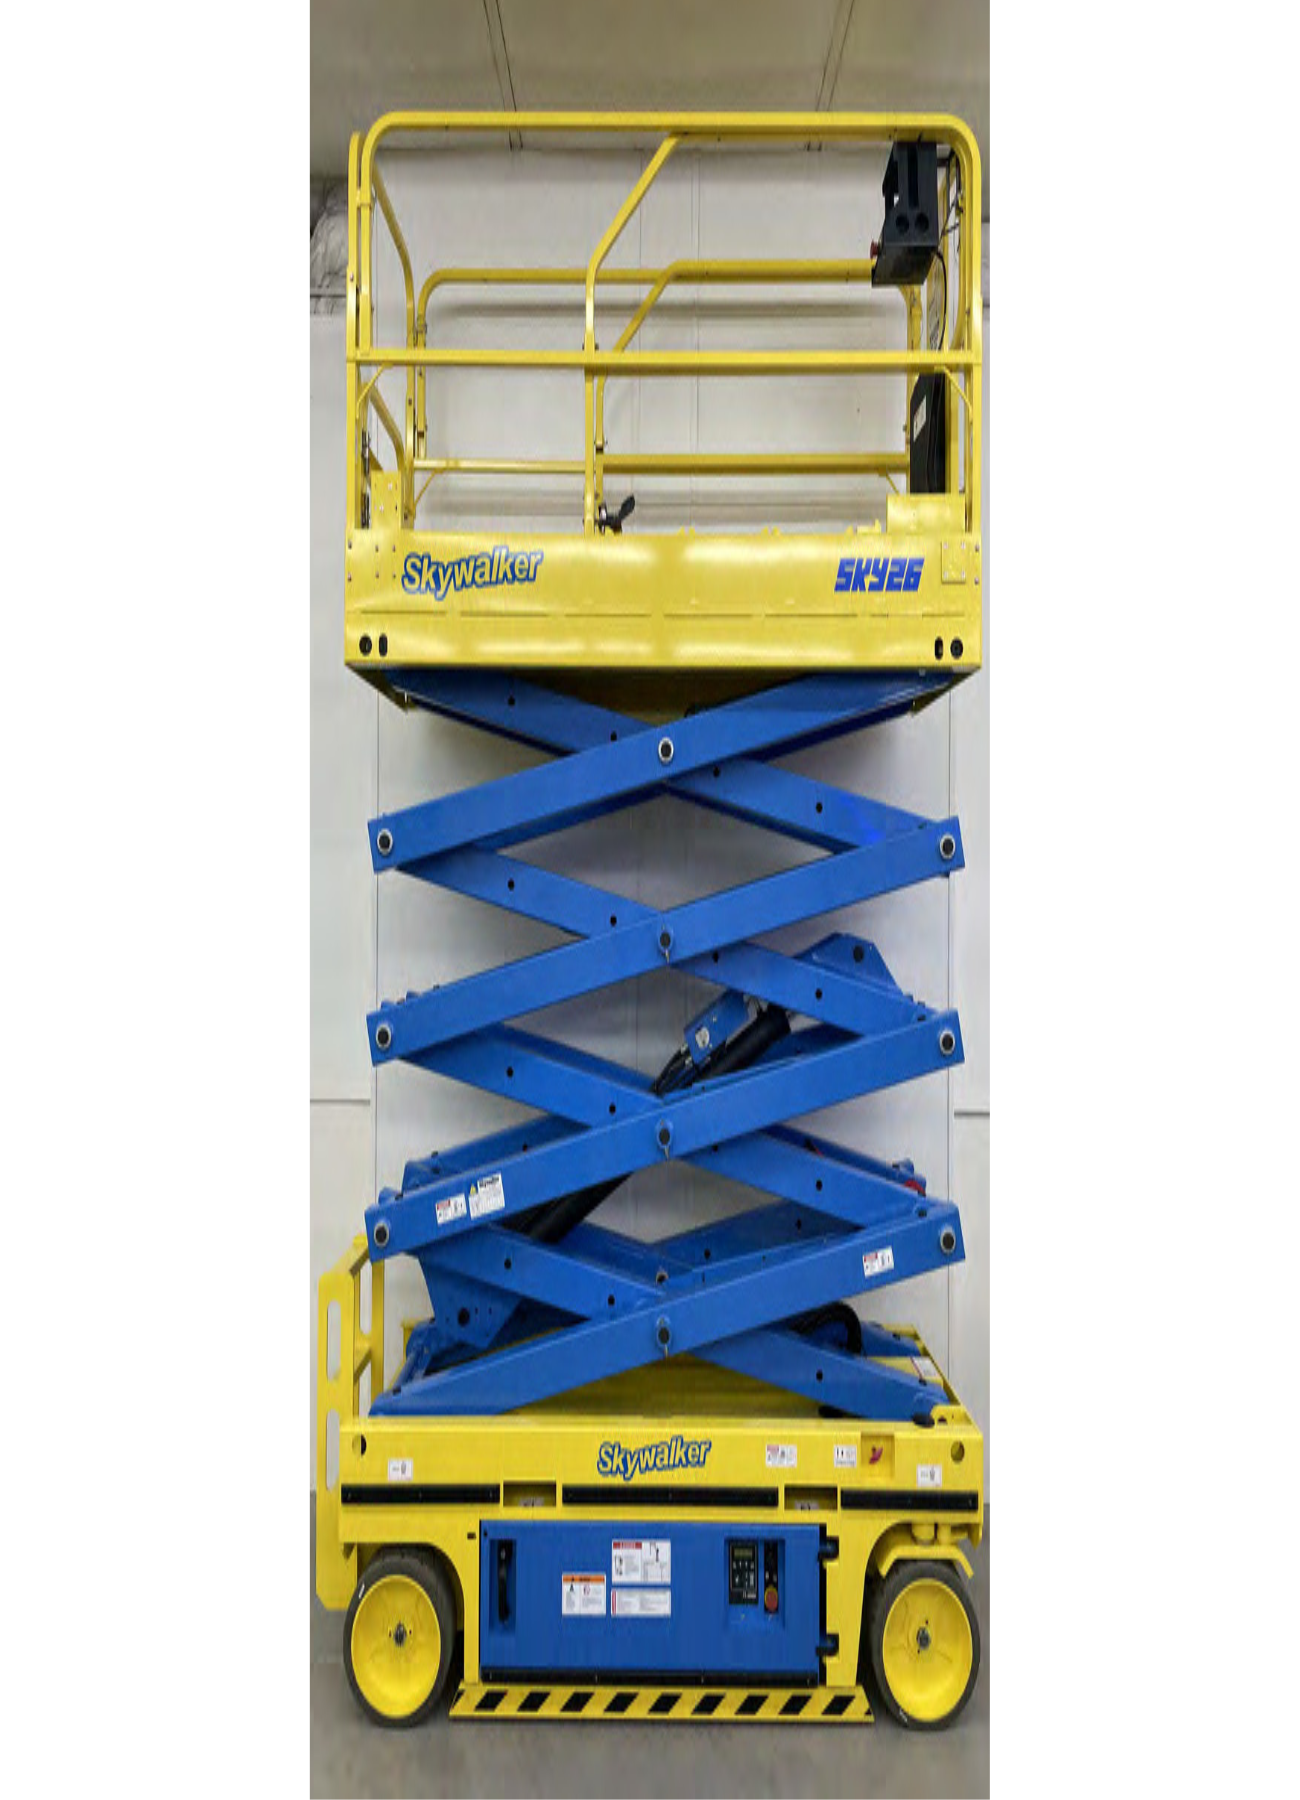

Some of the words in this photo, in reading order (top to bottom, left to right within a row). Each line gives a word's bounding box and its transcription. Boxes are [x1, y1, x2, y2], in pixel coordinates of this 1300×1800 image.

[402, 546, 544, 601] Skywalker
[834, 558, 925, 592] SKY26
[597, 1434, 712, 1481] Skywalker
